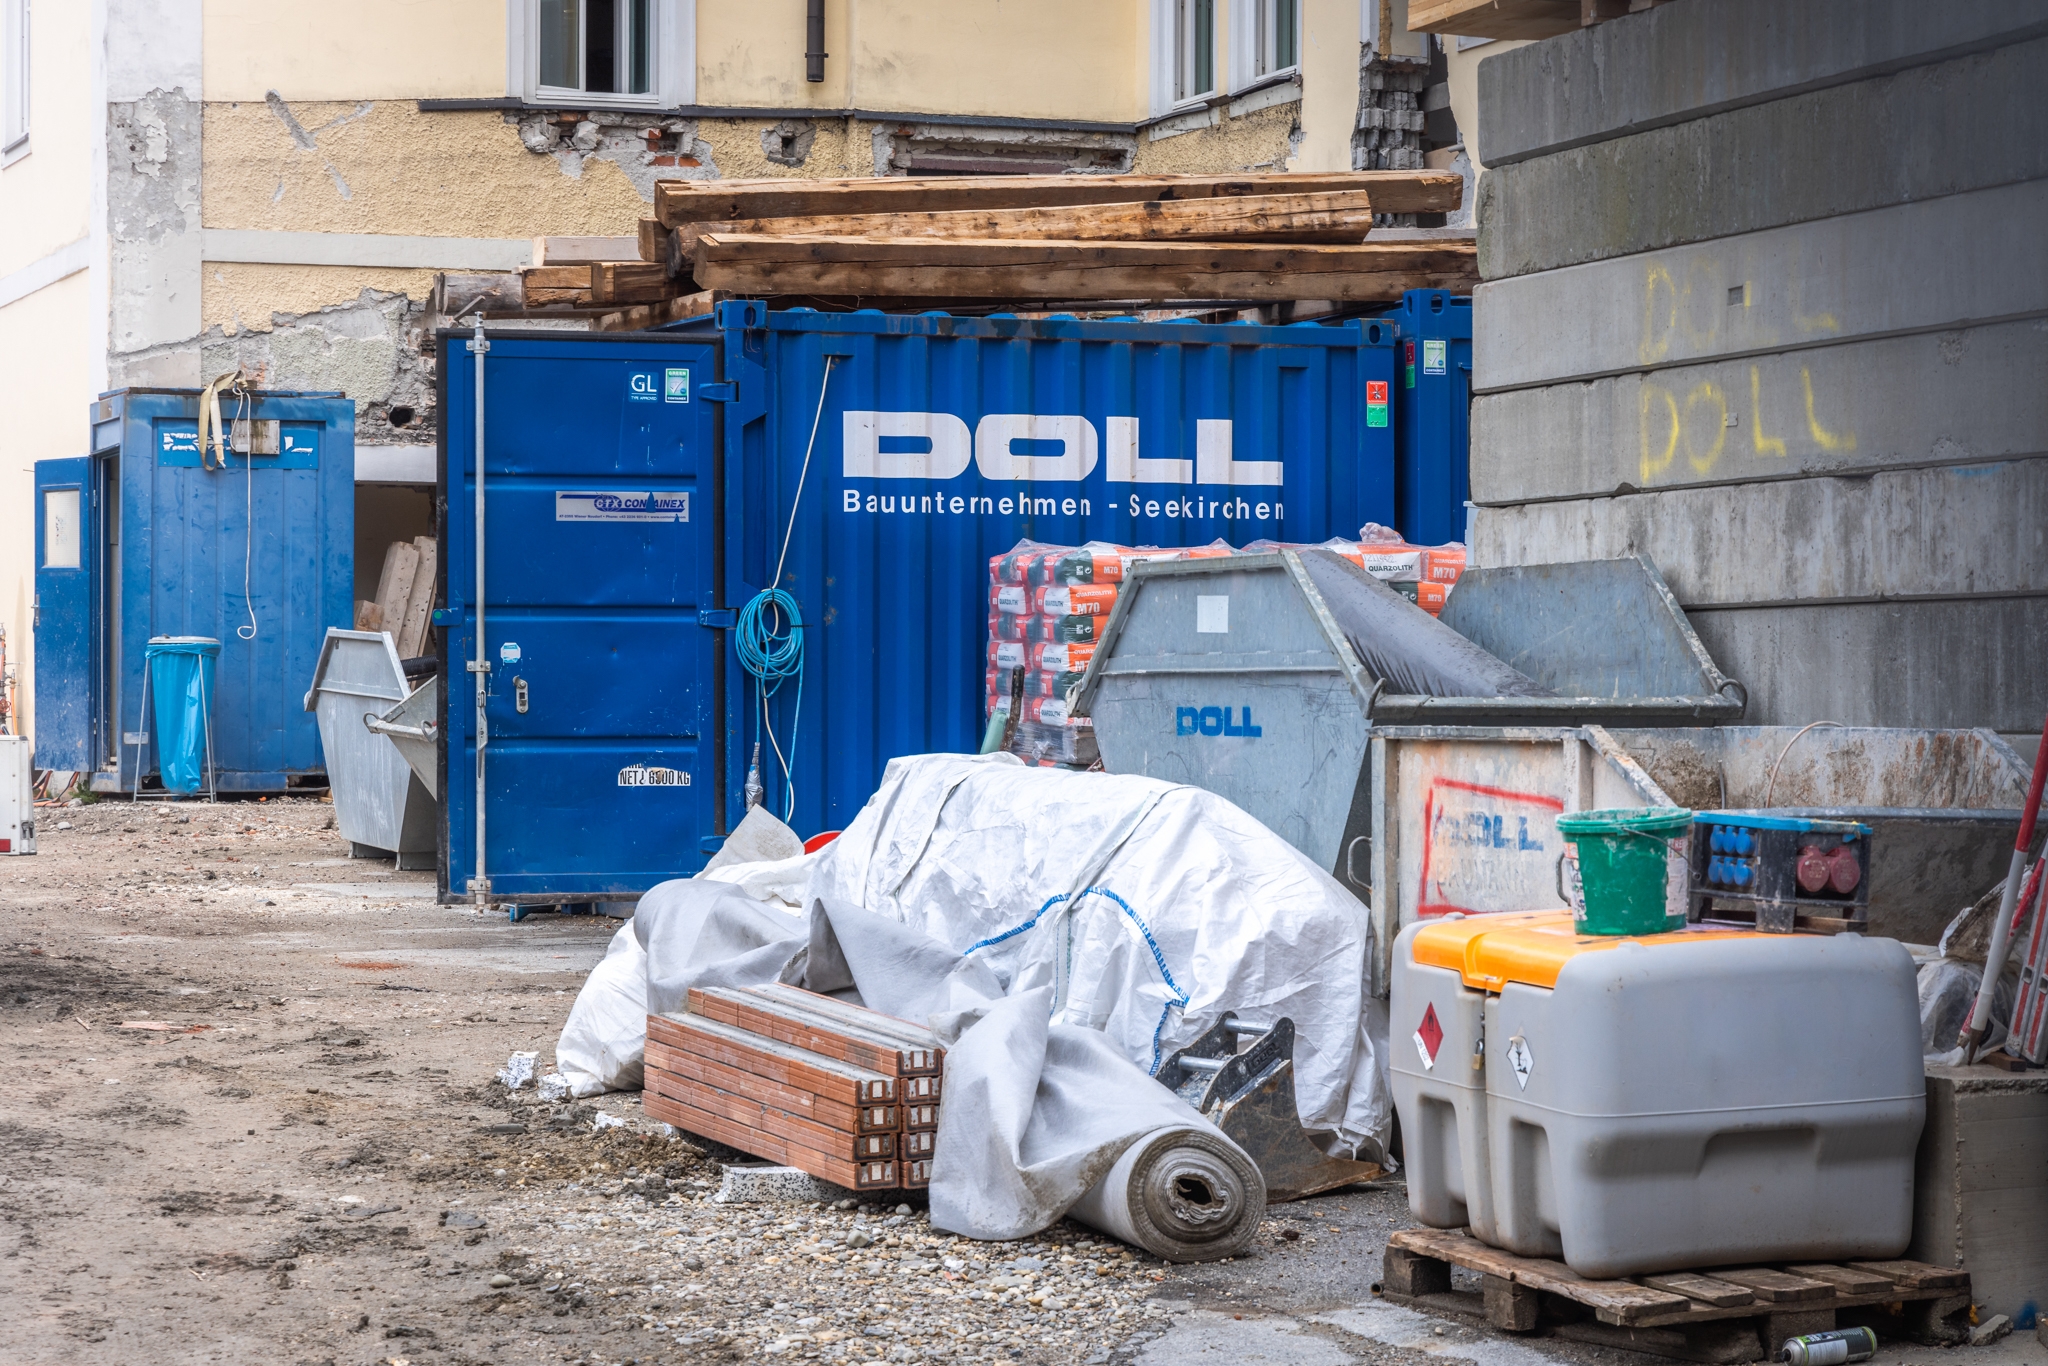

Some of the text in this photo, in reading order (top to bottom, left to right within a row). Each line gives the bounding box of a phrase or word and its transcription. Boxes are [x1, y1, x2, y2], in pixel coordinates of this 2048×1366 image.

[631, 374, 657, 392] GL
[1639, 365, 1857, 486] DOLL
[843, 410, 1284, 485] DOLL
[596, 499, 686, 508] CTX CONAINEX
[843, 489, 1091, 516] Bauunternehmen
[1129, 493, 1285, 520] Seekirchen
[1103, 566, 1118, 574] M70
[1368, 564, 1414, 572] QUARZOLITH
[1433, 567, 1456, 579] M70
[1427, 593, 1442, 602] M70
[1076, 602, 1100, 614] M70
[1075, 660, 1090, 672] M7
[1176, 706, 1262, 737] DOLL
[620, 770, 638, 785] NET
[677, 771, 690, 785] KG
